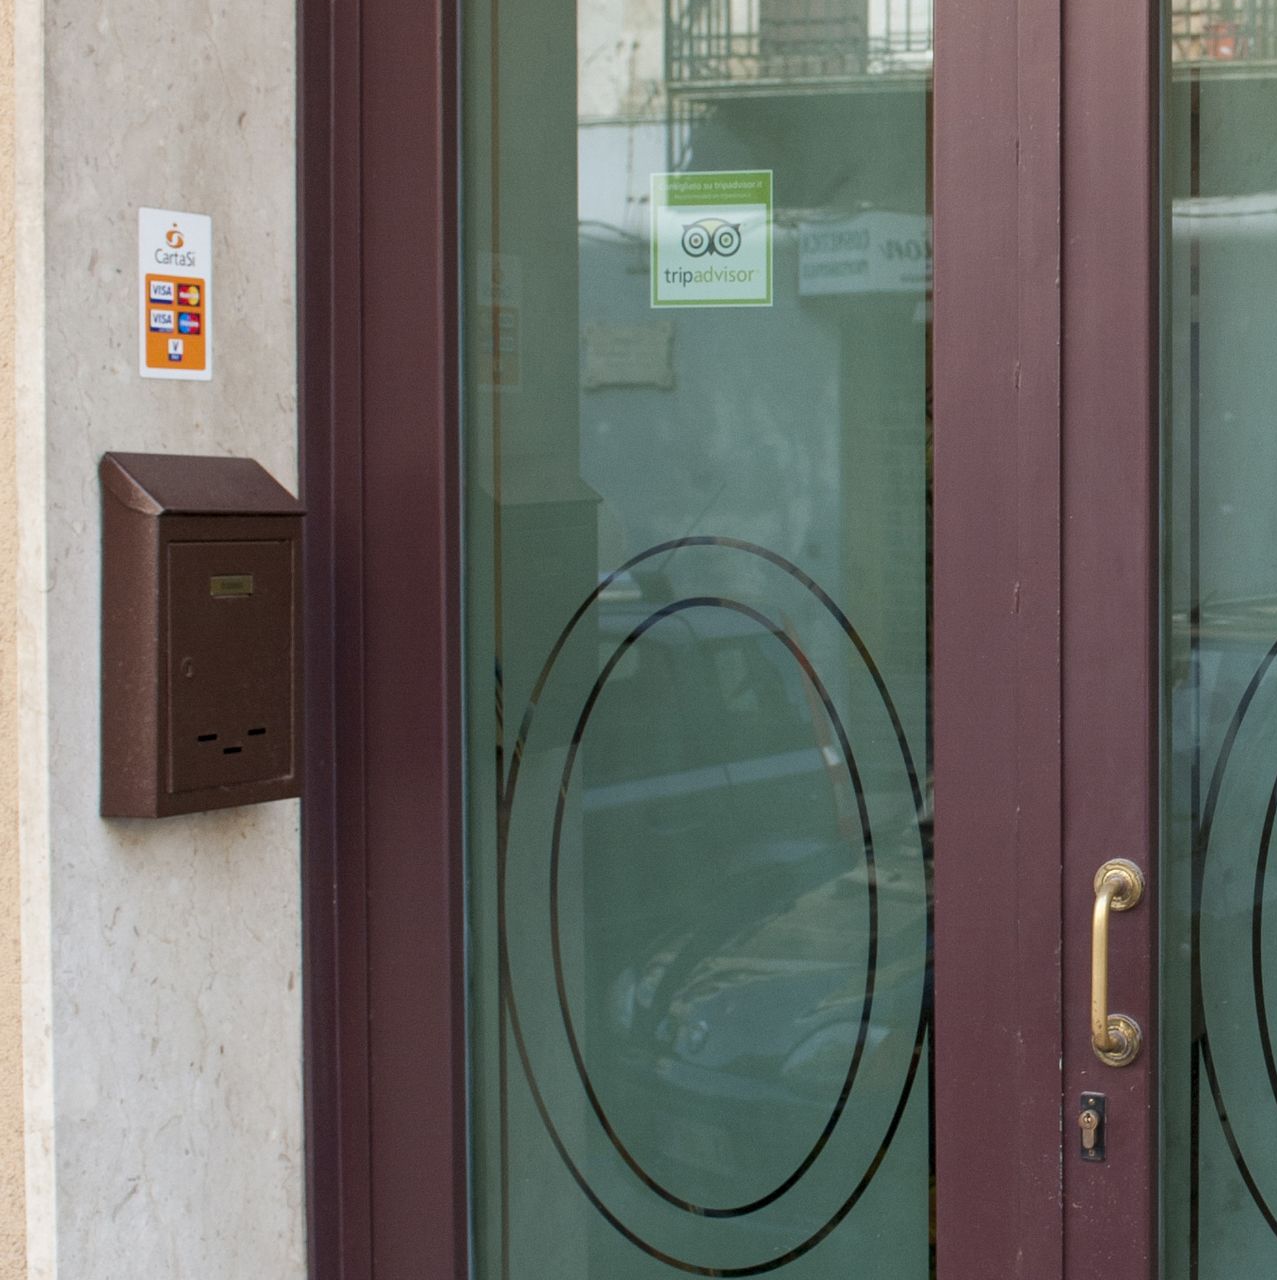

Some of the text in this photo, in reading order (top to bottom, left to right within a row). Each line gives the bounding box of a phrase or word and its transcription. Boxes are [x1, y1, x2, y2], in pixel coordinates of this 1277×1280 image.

[664, 266, 755, 287] tripadvisor
[153, 283, 172, 296] VISA
[153, 312, 172, 324] VISA
